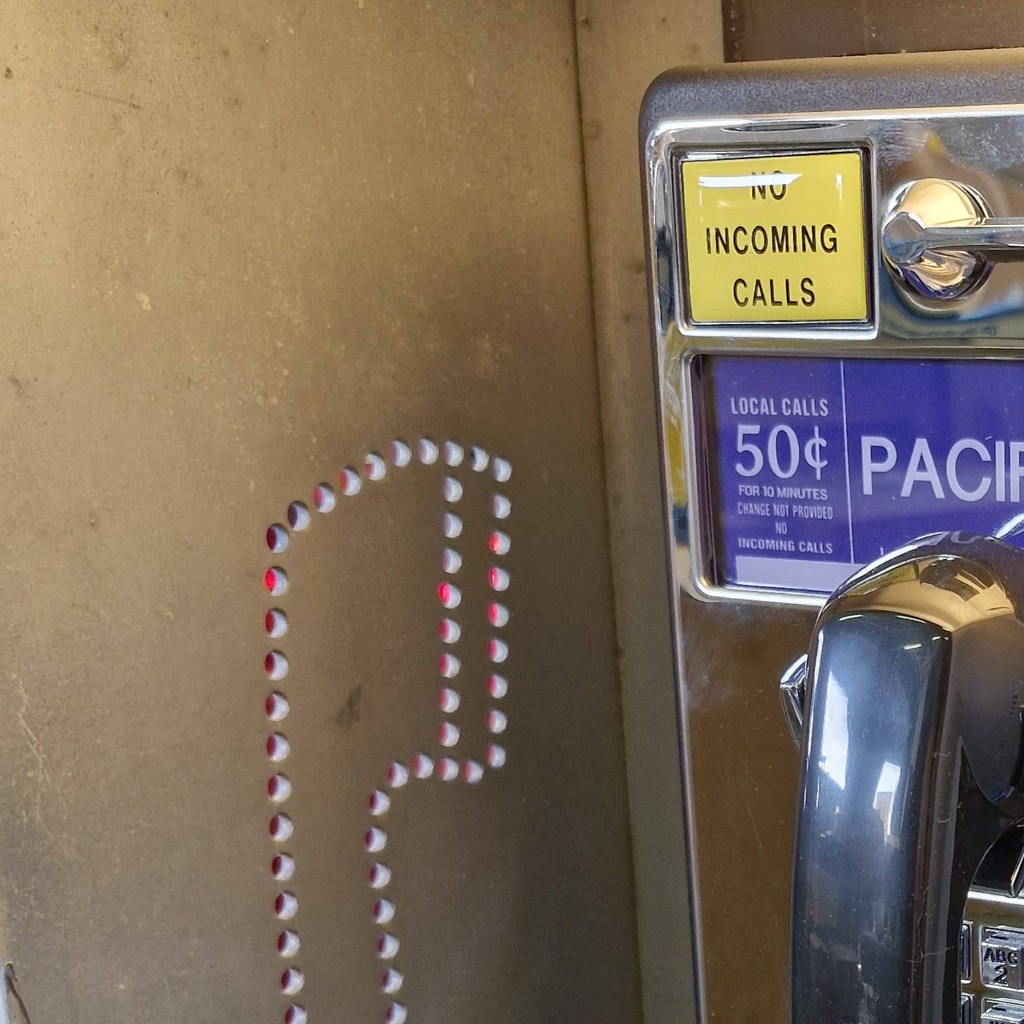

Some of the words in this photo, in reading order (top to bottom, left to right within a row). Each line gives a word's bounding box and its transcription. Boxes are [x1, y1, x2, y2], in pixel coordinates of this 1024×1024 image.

[751, 170, 787, 200] NO
[706, 224, 838, 255] INCOMING
[733, 278, 816, 307] CALLS
[731, 397, 778, 416] LOCAL
[782, 398, 829, 417] CALLS
[735, 424, 829, 481] 50¢
[738, 484, 761, 498] FOR
[763, 485, 775, 498] 10
[777, 487, 828, 501] MINUTES
[737, 502, 770, 517] CHANGE
[773, 504, 789, 519] NOT
[792, 505, 834, 520] PROVIDED
[775, 522, 788, 535] NO
[738, 537, 795, 552] INCOMING
[798, 541, 834, 555] CALLS
[983, 947, 1018, 967] ABC
[993, 965, 1009, 986] 2
